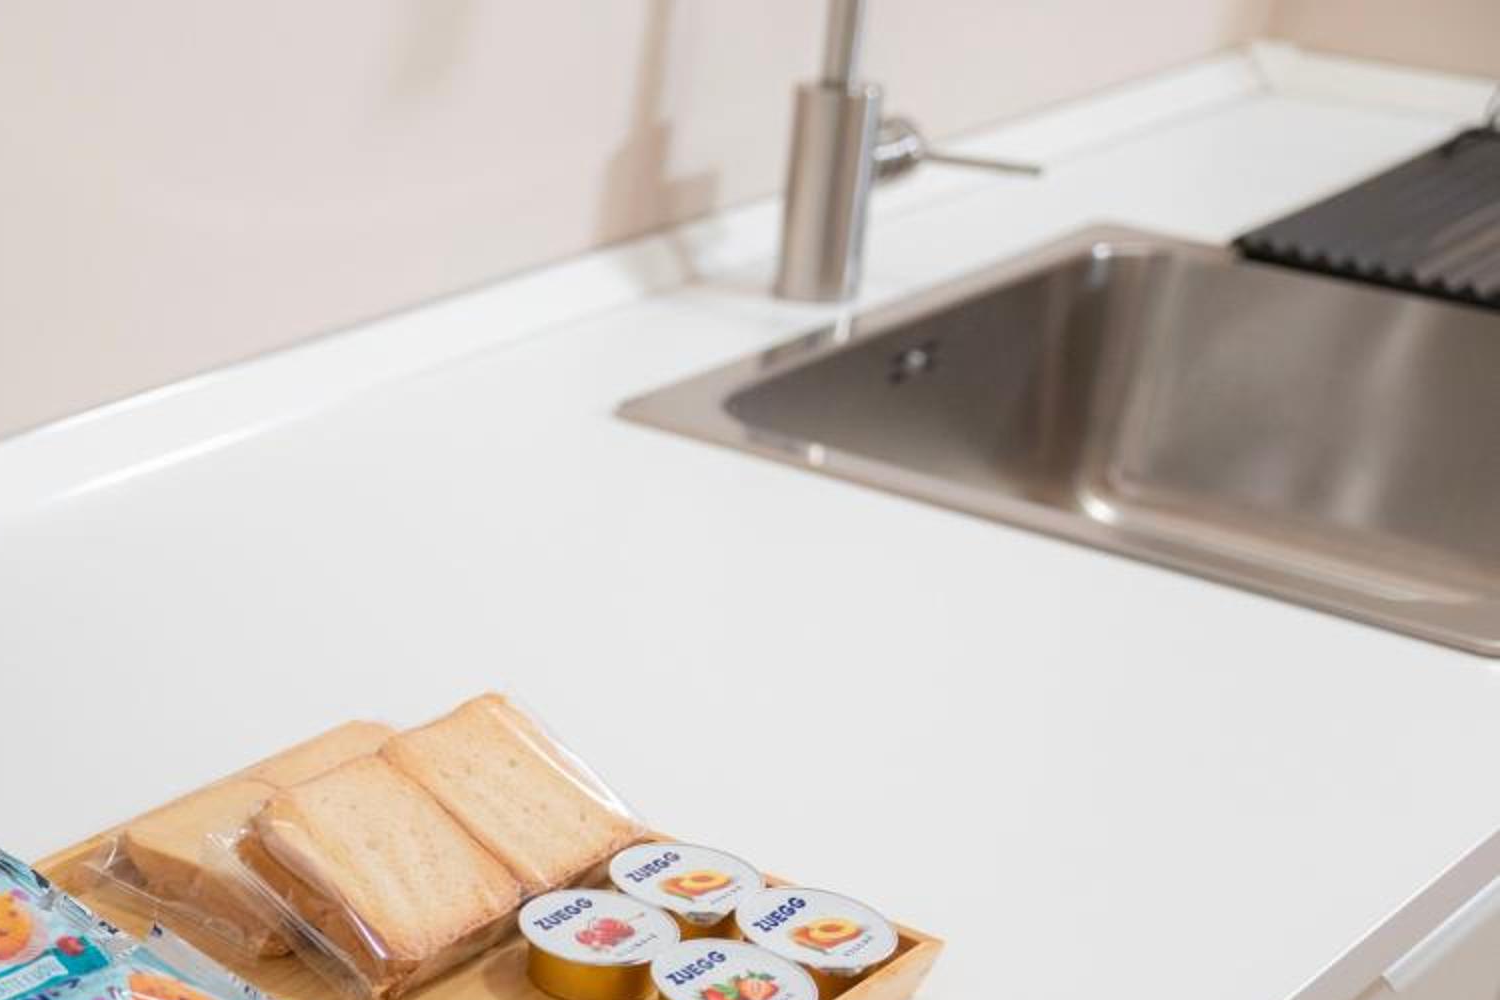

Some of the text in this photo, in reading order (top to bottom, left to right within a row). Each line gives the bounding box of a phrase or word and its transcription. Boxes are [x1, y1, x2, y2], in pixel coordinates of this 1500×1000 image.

[624, 850, 681, 884] ZUEGG
[532, 897, 594, 931] ZUEGG
[752, 897, 807, 933] ZUEGG
[665, 950, 727, 985] ZUEGG
